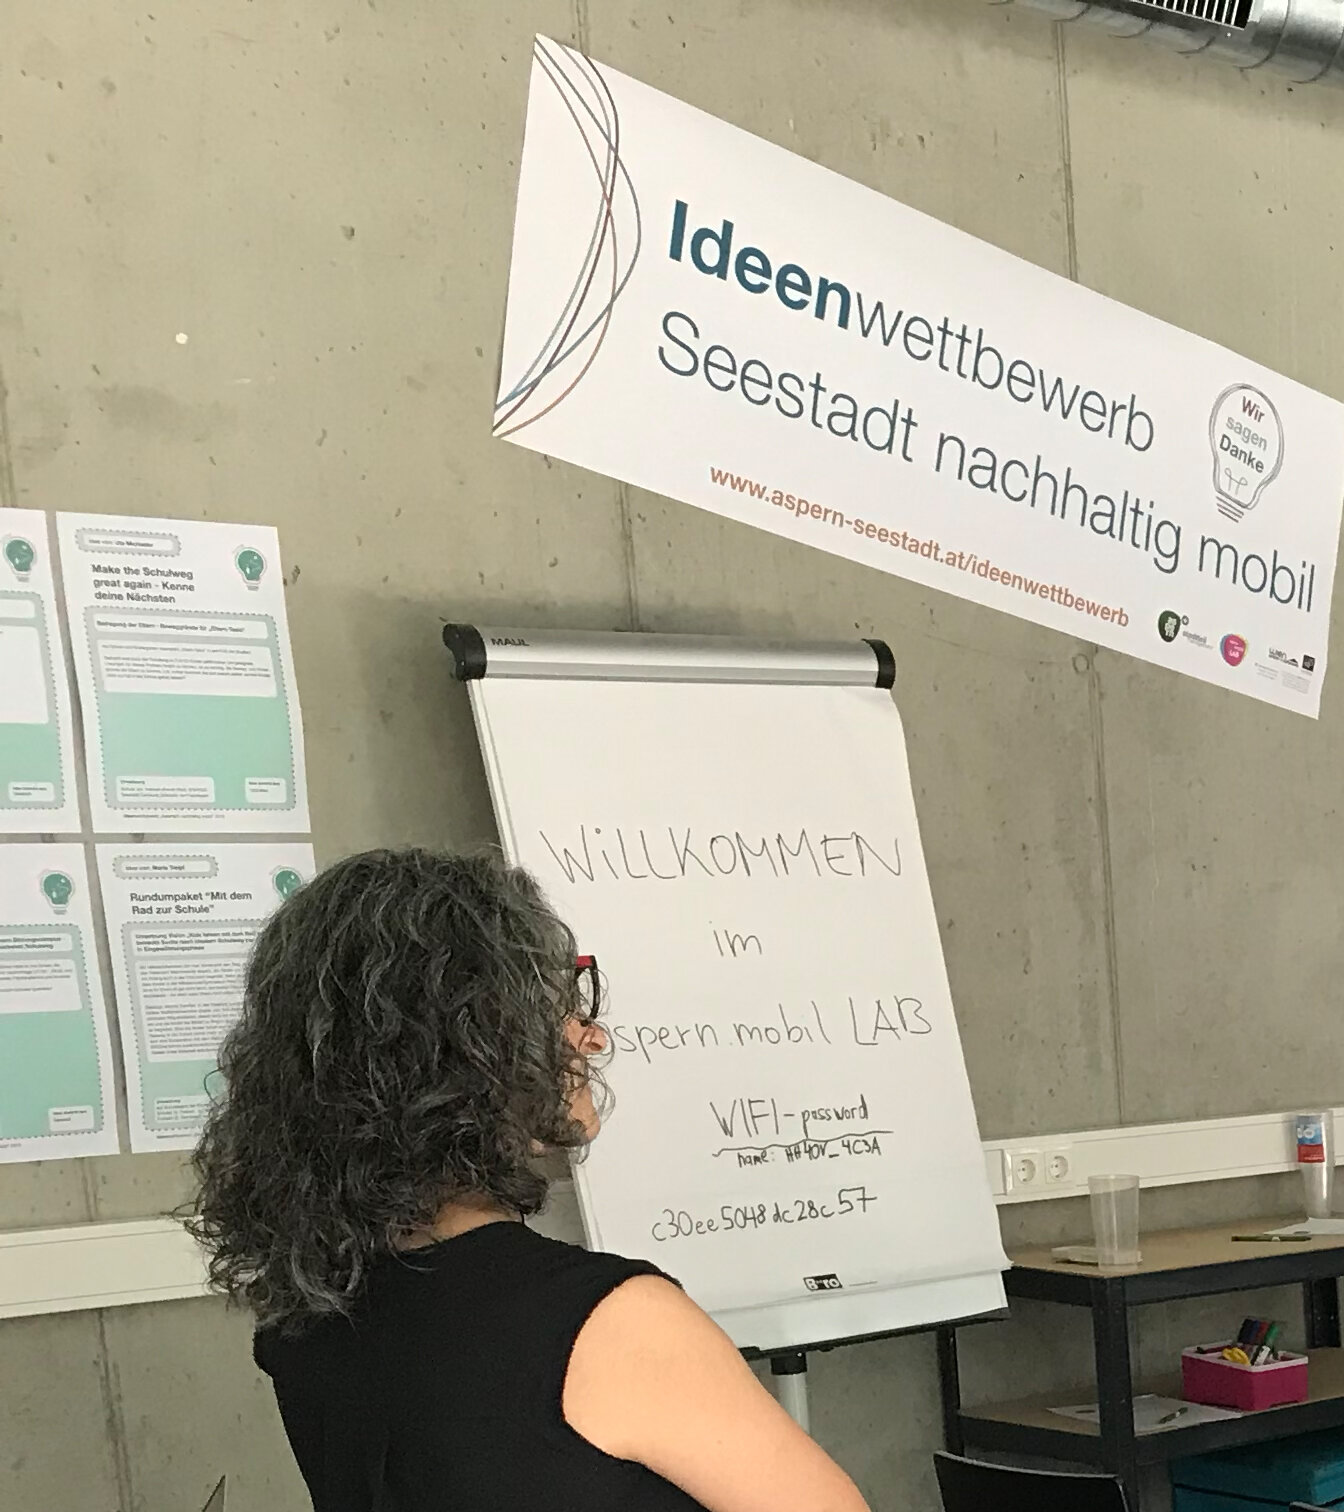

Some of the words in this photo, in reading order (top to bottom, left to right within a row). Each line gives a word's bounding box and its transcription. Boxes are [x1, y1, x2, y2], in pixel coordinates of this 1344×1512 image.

[667, 199, 1155, 452] Ideenwettbewerb
[1241, 395, 1266, 423] Wir
[1224, 414, 1268, 456] sagen
[657, 310, 920, 463] Seestadt
[936, 430, 1182, 573] nachhaltig
[1199, 533, 1315, 612] mobil
[1220, 433, 1266, 476] Danke
[710, 463, 1129, 628] www.aspern-seestadt.at/ideenwettbewerb
[92, 564, 121, 575] Make
[123, 566, 140, 576] the
[142, 567, 194, 580] Schulweg
[93, 578, 121, 588] great
[124, 580, 152, 590] again
[162, 581, 195, 592] Kenne
[95, 591, 124, 601] deine
[127, 591, 176, 603] Nächsten
[490, 636, 530, 647] MAUL
[130, 891, 203, 903] Rundumpaket
[230, 891, 252, 901] dem
[132, 904, 153, 915] Rad
[156, 906, 172, 915] zur
[709, 920, 762, 957] im
[849, 996, 932, 1046] LAB
